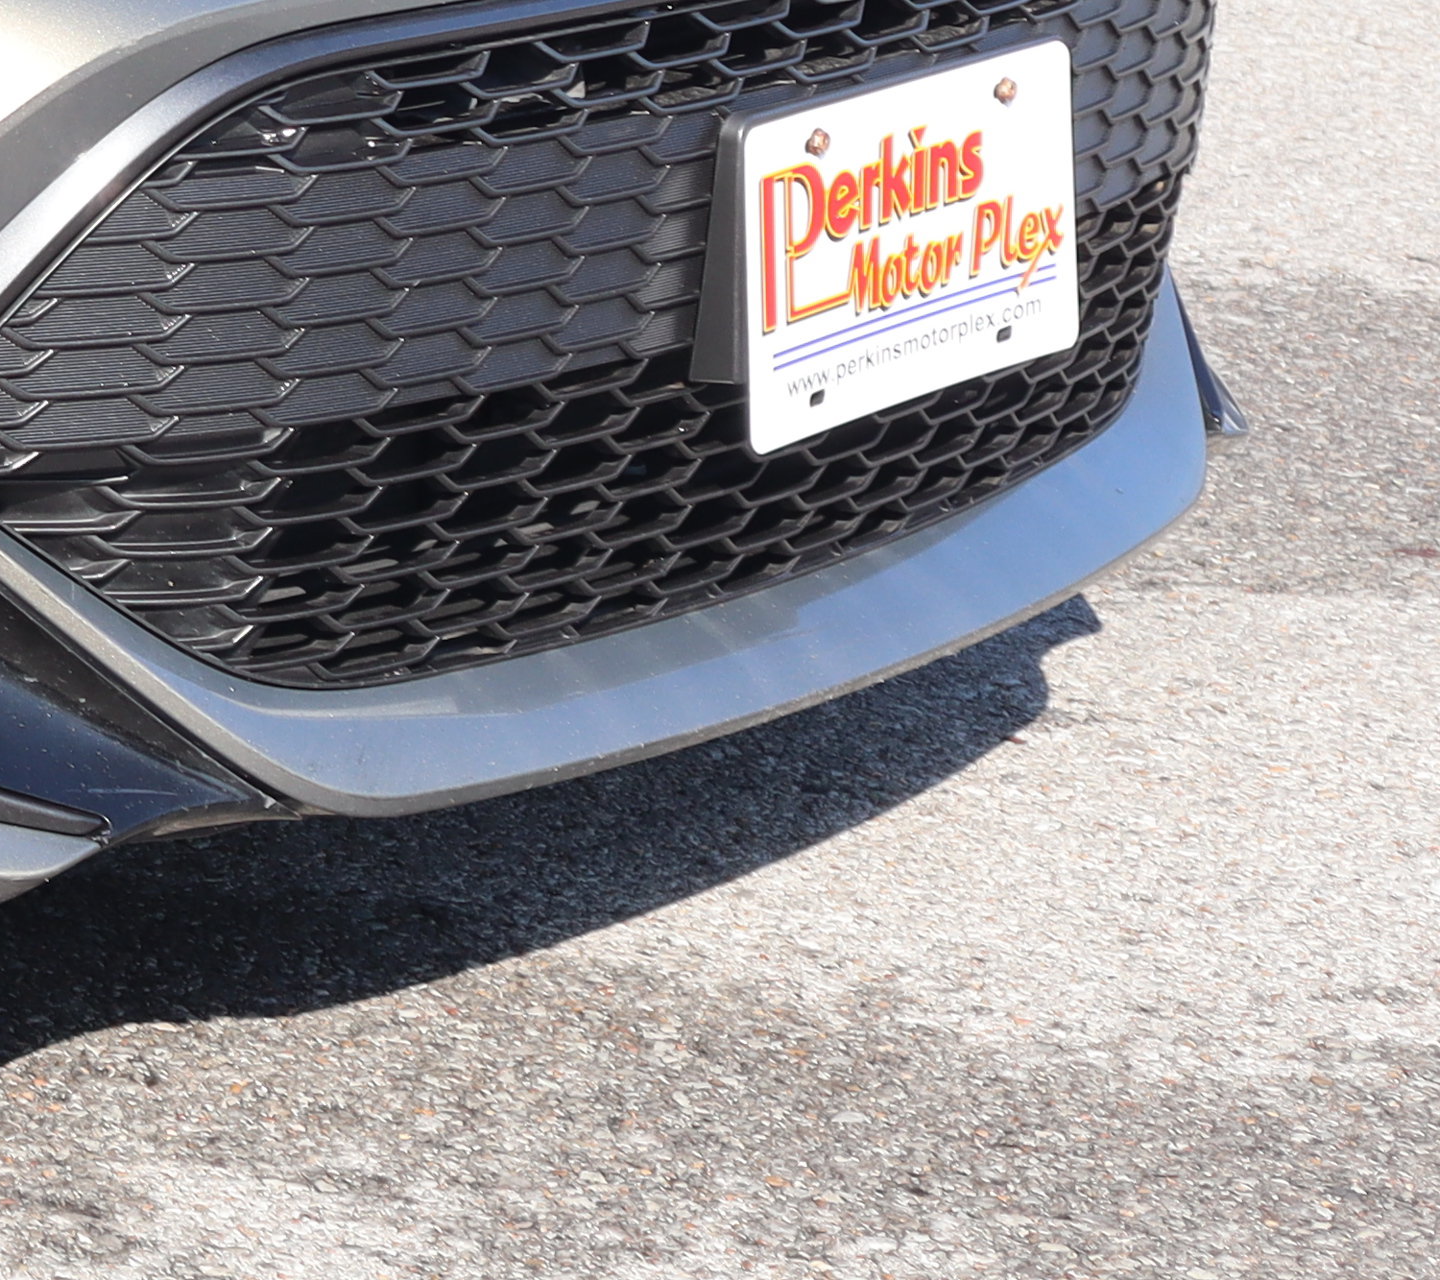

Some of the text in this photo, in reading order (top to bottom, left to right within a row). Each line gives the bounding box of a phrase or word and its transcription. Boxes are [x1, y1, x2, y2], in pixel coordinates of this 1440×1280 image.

[760, 126, 985, 336] Perkins
[847, 195, 1066, 314] Motor Plex
[786, 298, 1042, 397] www.perkinsmotorplex.com
